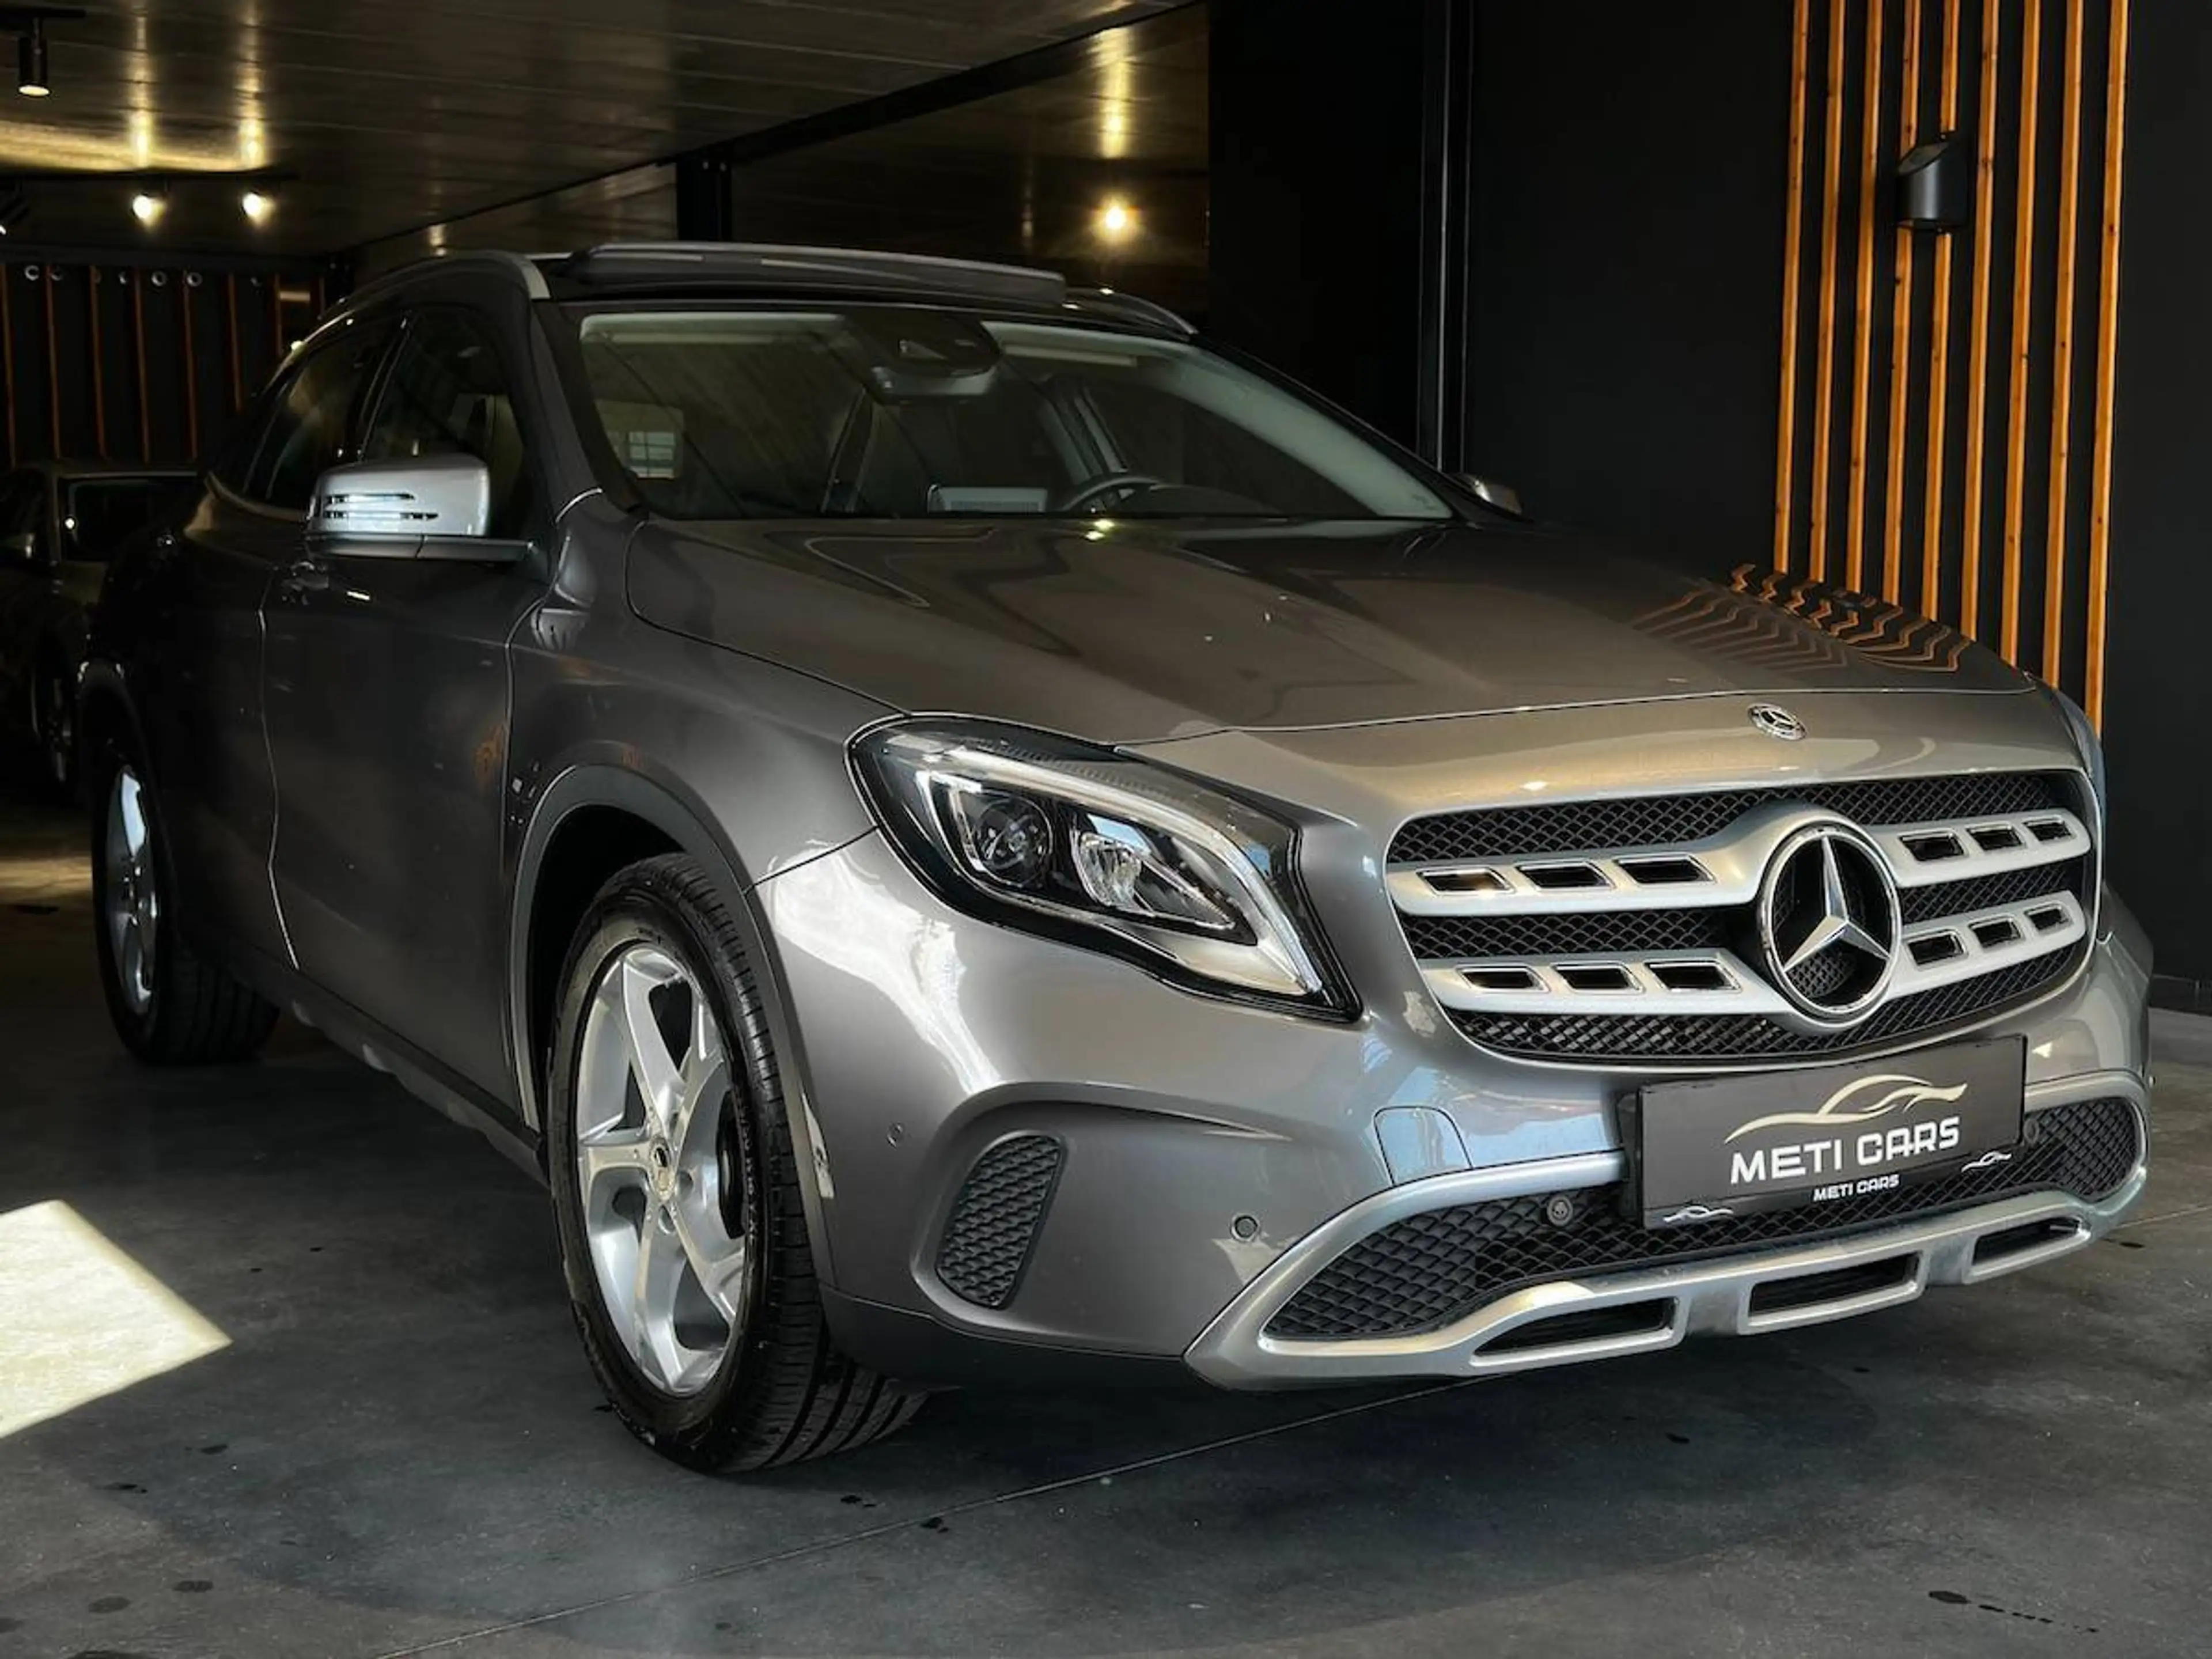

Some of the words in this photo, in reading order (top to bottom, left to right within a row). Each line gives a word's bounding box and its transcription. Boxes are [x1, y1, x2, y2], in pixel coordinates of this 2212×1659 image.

[1730, 1139, 1843, 1184] METI
[1857, 1116, 1960, 1166] CARS
[1813, 1183, 1854, 1202] METI
[1856, 1174, 1900, 1194] CARS
